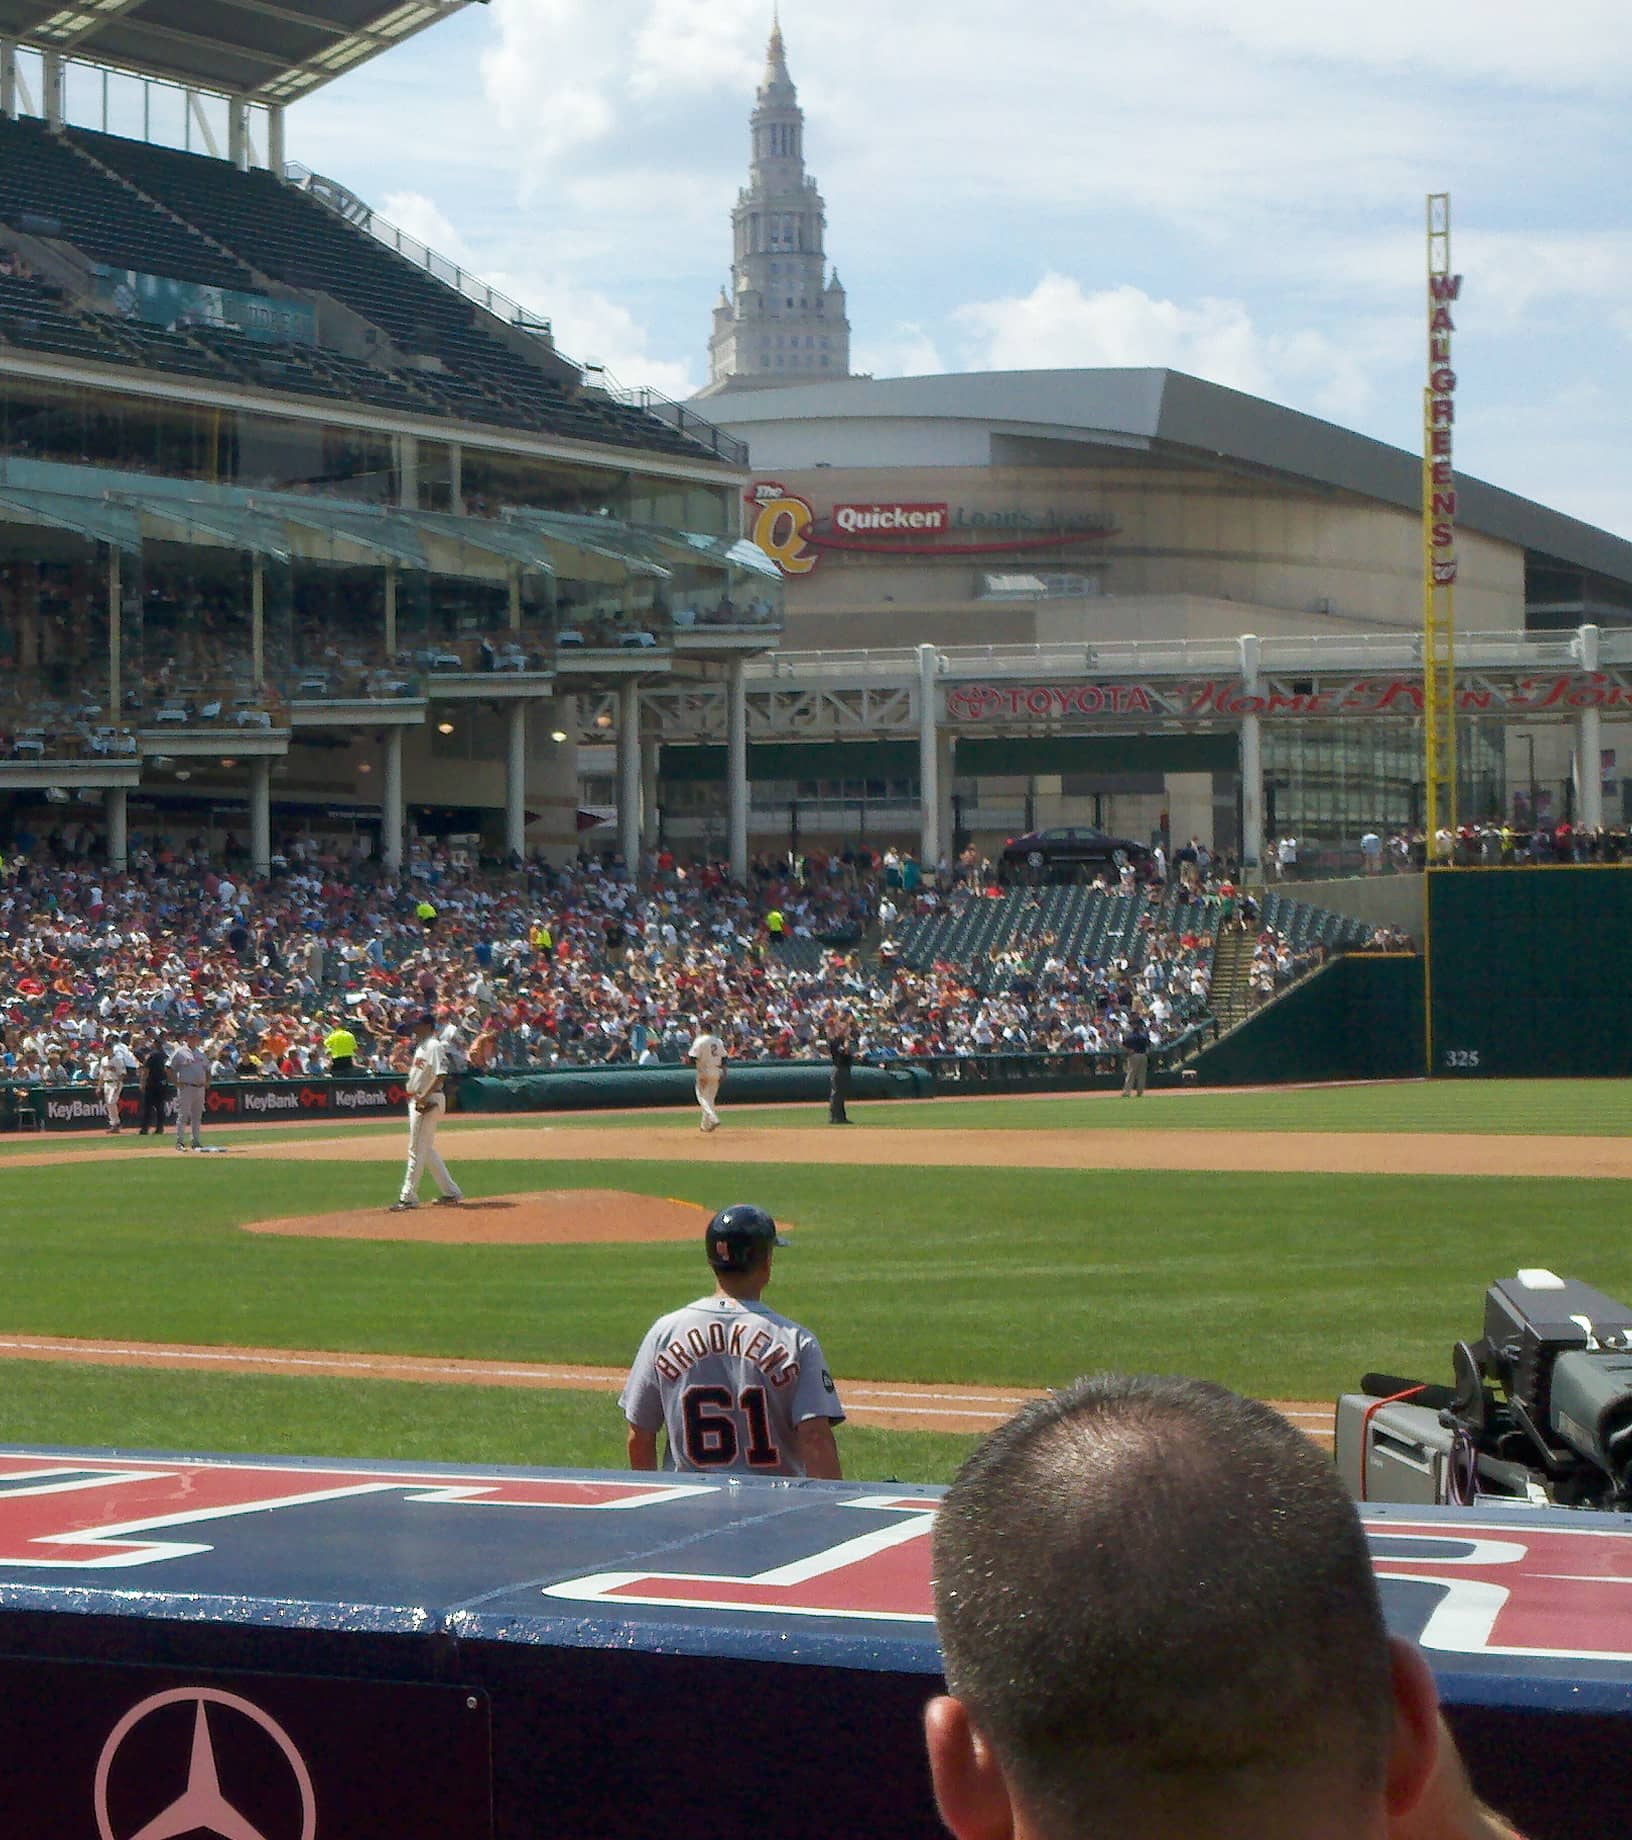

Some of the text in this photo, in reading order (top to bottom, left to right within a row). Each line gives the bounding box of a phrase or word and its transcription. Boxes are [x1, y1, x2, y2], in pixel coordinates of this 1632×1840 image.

[1430, 275, 1463, 548] WALGREENS
[837, 507, 943, 533] Quicken
[753, 497, 818, 574] Q
[1005, 686, 1152, 714] TOYOTA
[1446, 1050, 1480, 1067] 325
[244, 1092, 299, 1112] KeyBank
[335, 1089, 388, 1109] KeyBank
[655, 1322, 802, 1388] BROOKENS
[681, 1384, 781, 1469] 61
